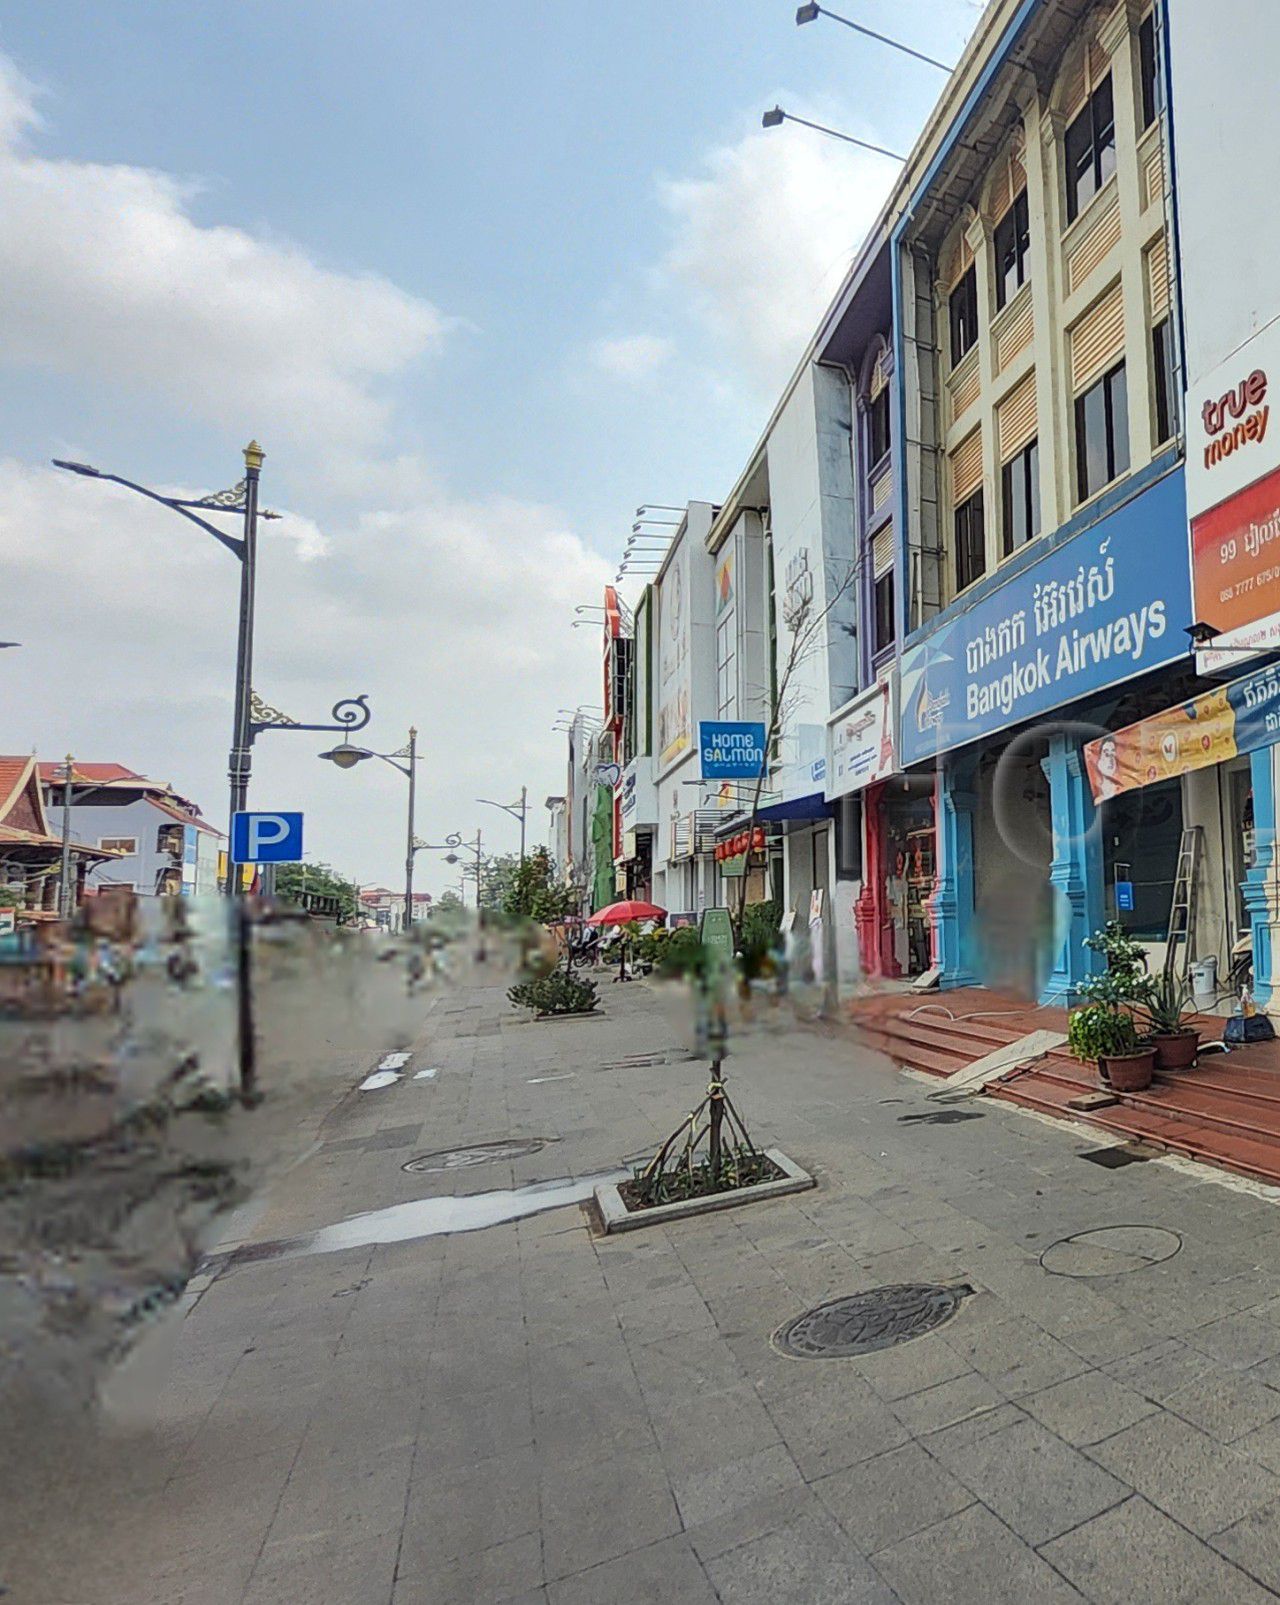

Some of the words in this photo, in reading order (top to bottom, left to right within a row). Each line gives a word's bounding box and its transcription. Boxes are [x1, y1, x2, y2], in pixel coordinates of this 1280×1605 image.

[1201, 368, 1268, 436] true
[1203, 405, 1270, 470] money
[1220, 539, 1237, 564] 99
[965, 610, 1026, 674] បាងកក
[966, 648, 1051, 721] Bangkok
[1055, 600, 1167, 681] Airways
[248, 816, 290, 860] P
